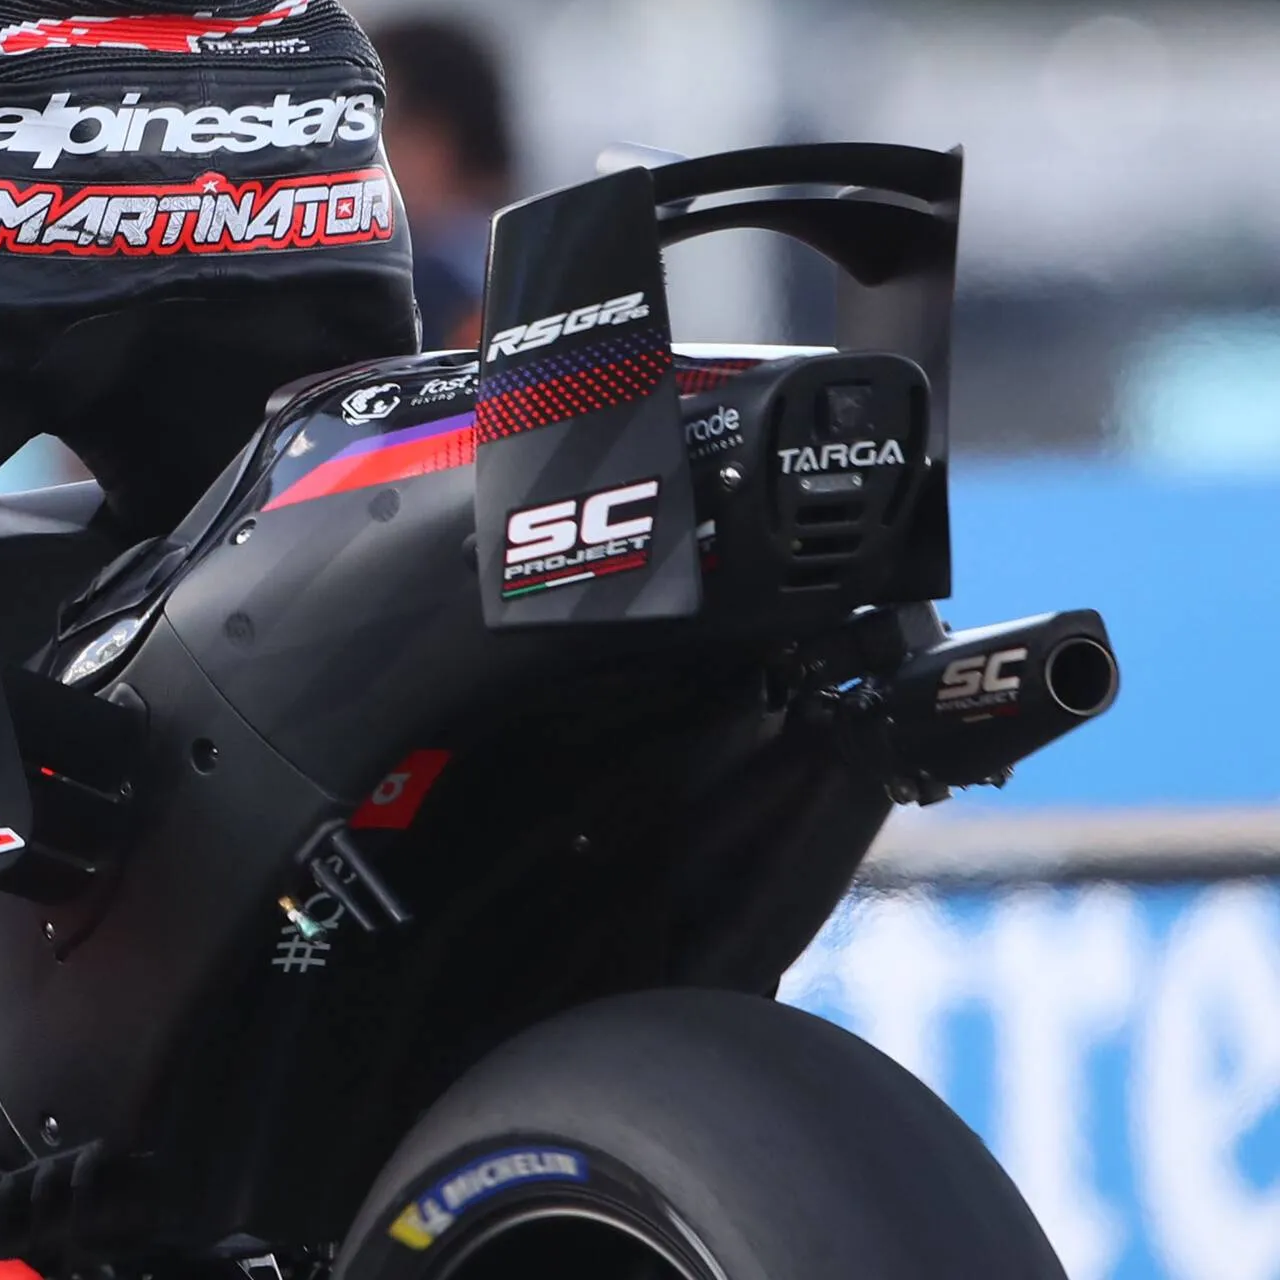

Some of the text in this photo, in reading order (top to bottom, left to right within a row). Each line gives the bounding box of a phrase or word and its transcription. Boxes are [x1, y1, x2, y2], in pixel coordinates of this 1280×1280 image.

[419, 372, 472, 396] fast
[777, 438, 905, 475] TARGA
[504, 480, 659, 566] SC
[503, 535, 651, 580] PROJECT
[938, 648, 1027, 700] SC
[444, 1152, 576, 1208] MICHELIN
